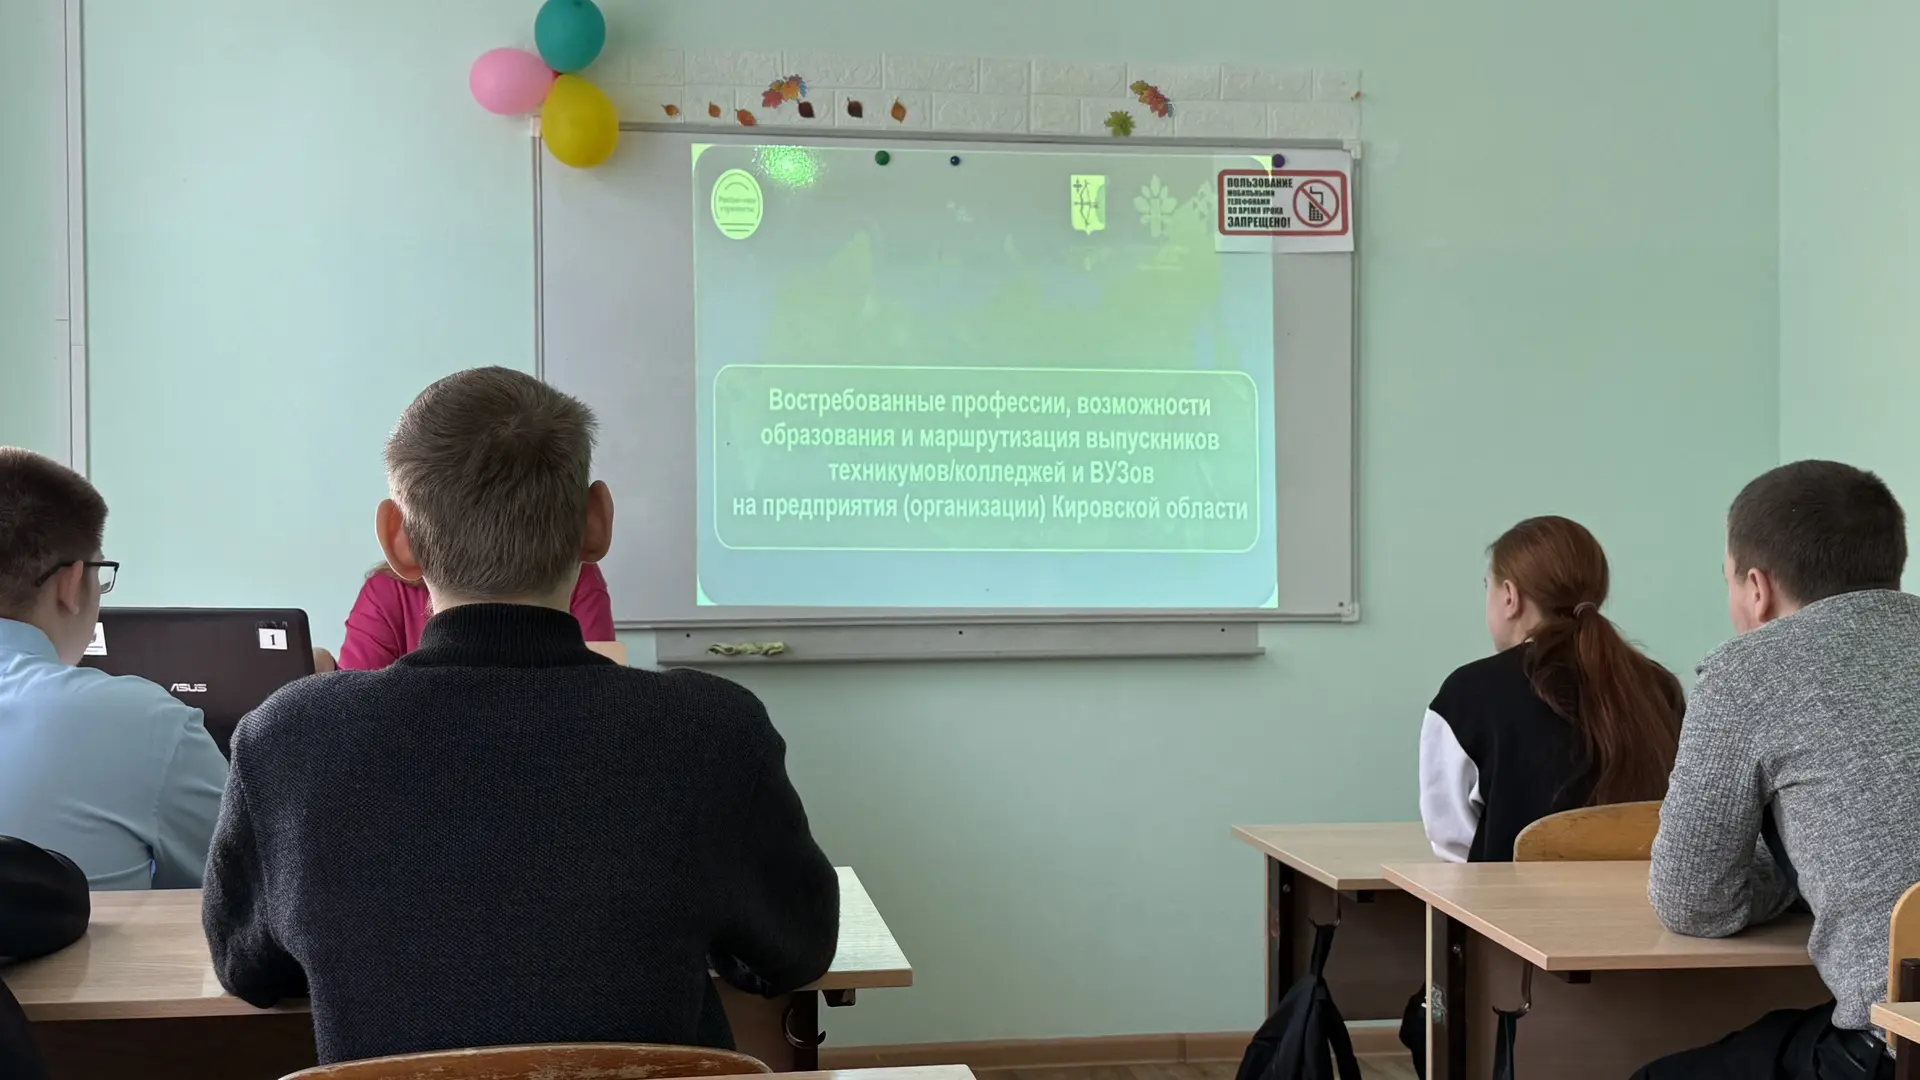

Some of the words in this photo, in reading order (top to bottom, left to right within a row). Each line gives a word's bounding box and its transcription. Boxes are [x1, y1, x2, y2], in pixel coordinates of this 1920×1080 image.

[1227, 178, 1293, 188] ПОЛЬЗОВАНИЕ
[1227, 217, 1291, 229] ЗАПРЕЩЕНО!
[769, 387, 946, 417] Востребованные
[951, 390, 1071, 418] профессии,
[1077, 396, 1211, 416] возможности
[760, 422, 895, 451] образования
[902, 429, 913, 447] и
[920, 429, 1080, 453] маршрутизация
[1086, 431, 1220, 455] выпускников
[828, 459, 1066, 487] техникумов/колледжей
[1072, 465, 1084, 483] и
[1090, 460, 1155, 484] ВУЗов
[733, 497, 756, 516] на
[763, 496, 897, 522] предприятия
[904, 494, 1046, 523] (организации)
[1052, 495, 1160, 524] Кировской
[1166, 496, 1248, 520] области
[270, 634, 277, 646] 1
[170, 682, 208, 693] ASUS
